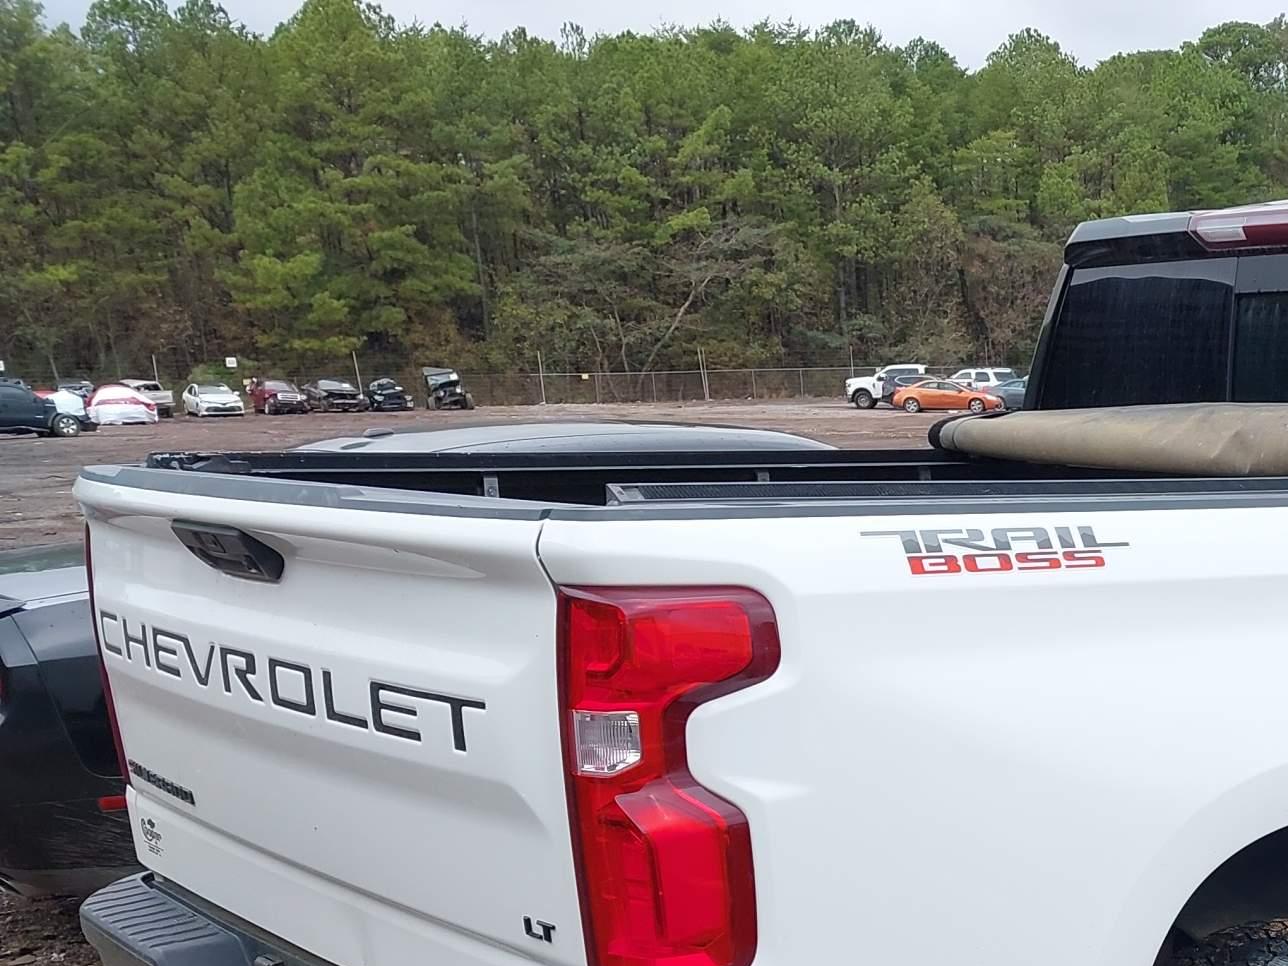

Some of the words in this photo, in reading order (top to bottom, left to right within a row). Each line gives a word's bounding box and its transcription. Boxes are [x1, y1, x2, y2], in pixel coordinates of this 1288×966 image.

[860, 526, 1130, 553] TRAIL
[906, 550, 1106, 575] BOSS
[100, 610, 487, 752] CHEVROLET
[523, 915, 556, 943] LT
